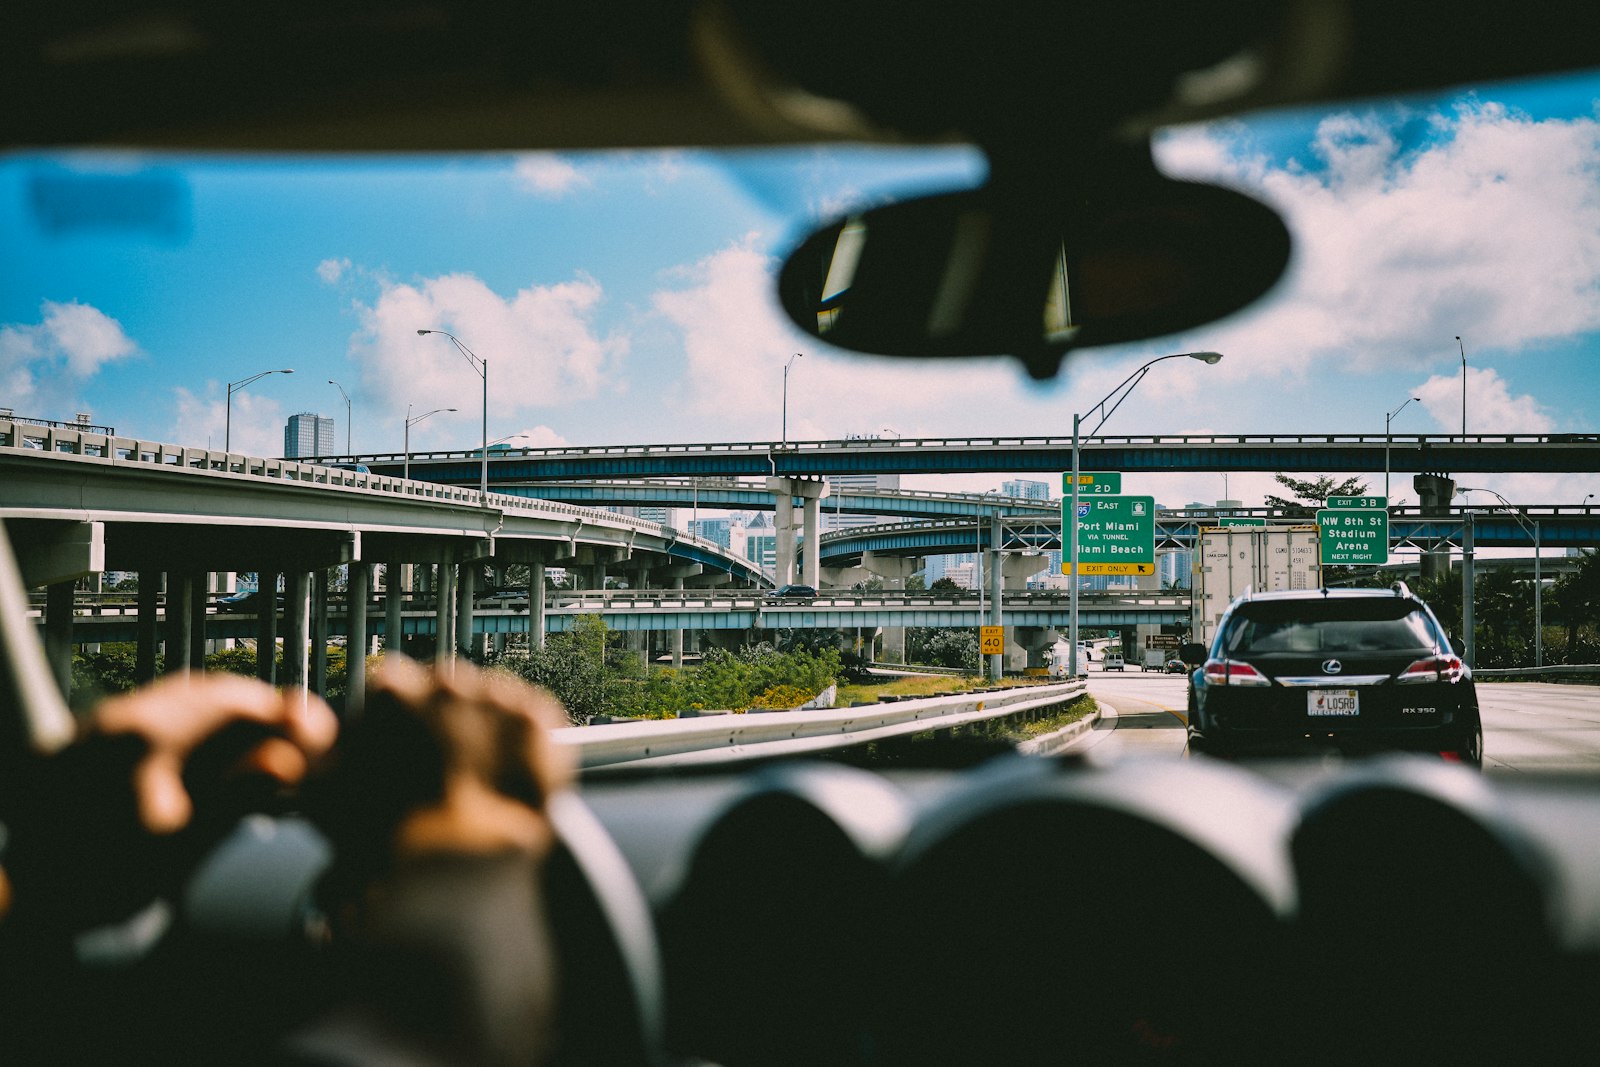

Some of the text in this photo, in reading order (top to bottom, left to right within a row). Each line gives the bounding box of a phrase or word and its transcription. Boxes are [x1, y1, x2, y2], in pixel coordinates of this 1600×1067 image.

[1322, 517, 1382, 526] NW 8th St
[1078, 522, 1139, 530] Port Miami
[1328, 529, 1376, 538] Stadium
[1078, 545, 1144, 553] iami Beach
[1335, 541, 1369, 550] Arena
[984, 638, 1000, 646] 40
